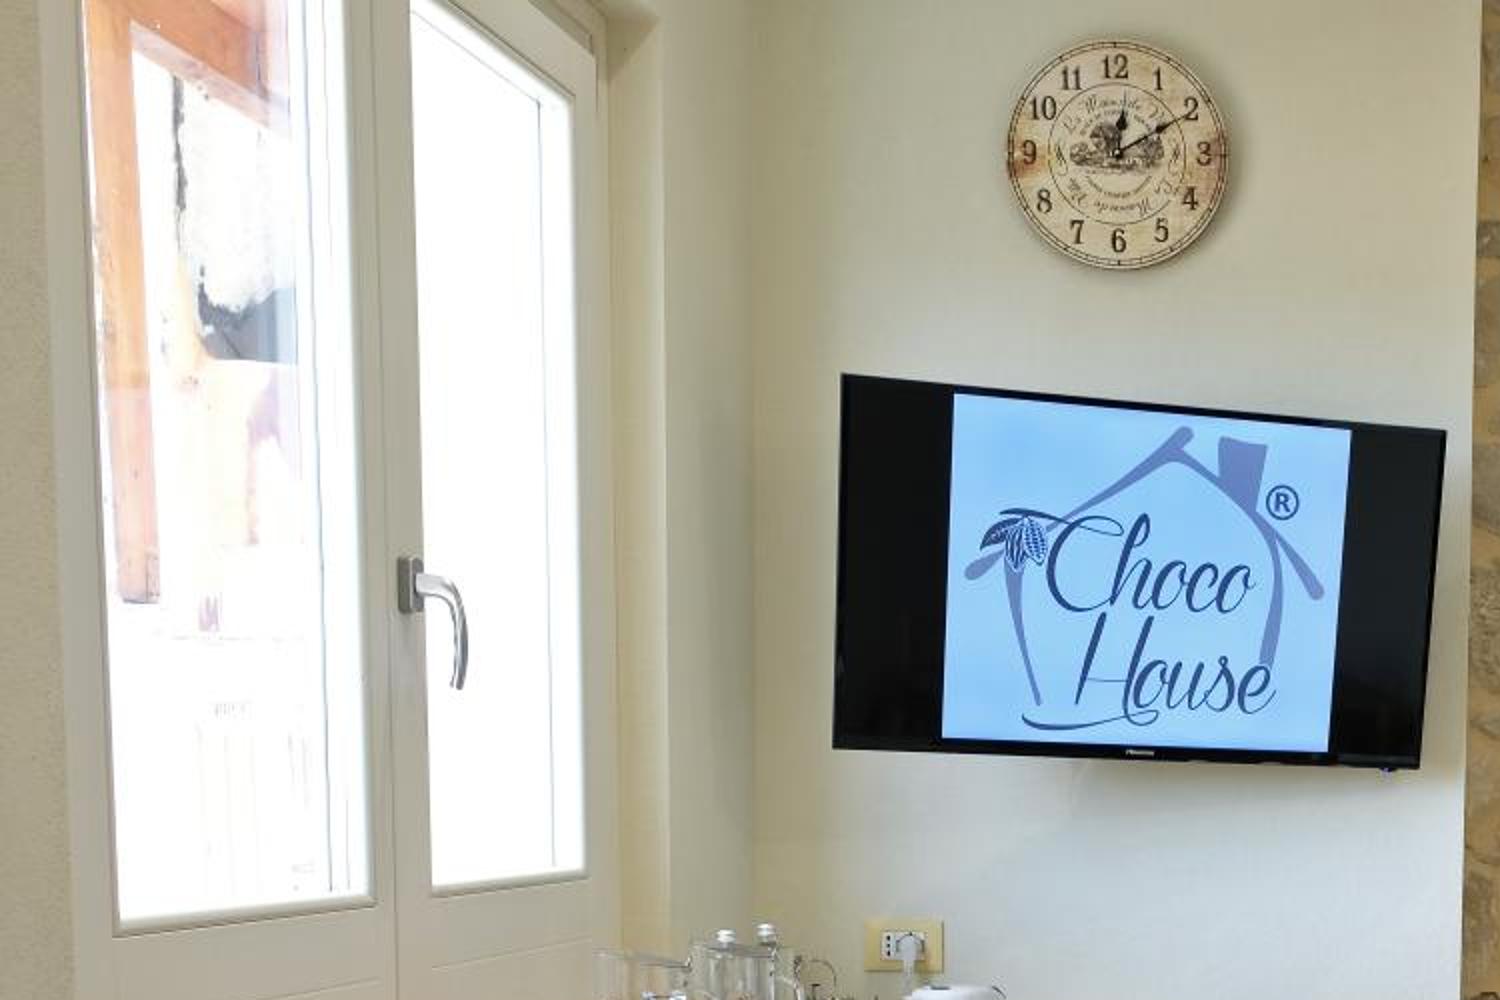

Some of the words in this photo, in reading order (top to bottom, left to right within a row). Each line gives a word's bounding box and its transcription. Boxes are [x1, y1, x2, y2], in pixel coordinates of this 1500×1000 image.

[1061, 66, 1082, 91] 11
[1102, 54, 1129, 79] 12
[1153, 66, 1164, 91] 1
[1030, 96, 1057, 121] 10
[1184, 97, 1199, 121] 2
[1022, 140, 1037, 165] 9
[1197, 142, 1212, 166] 3
[1036, 189, 1052, 214] 8
[1182, 186, 1199, 211] 4
[1070, 219, 1085, 244] 7
[1111, 229, 1126, 253] 6
[1154, 218, 1169, 242] 5
[1042, 512, 1256, 613] Choco
[1022, 612, 1277, 730] House
